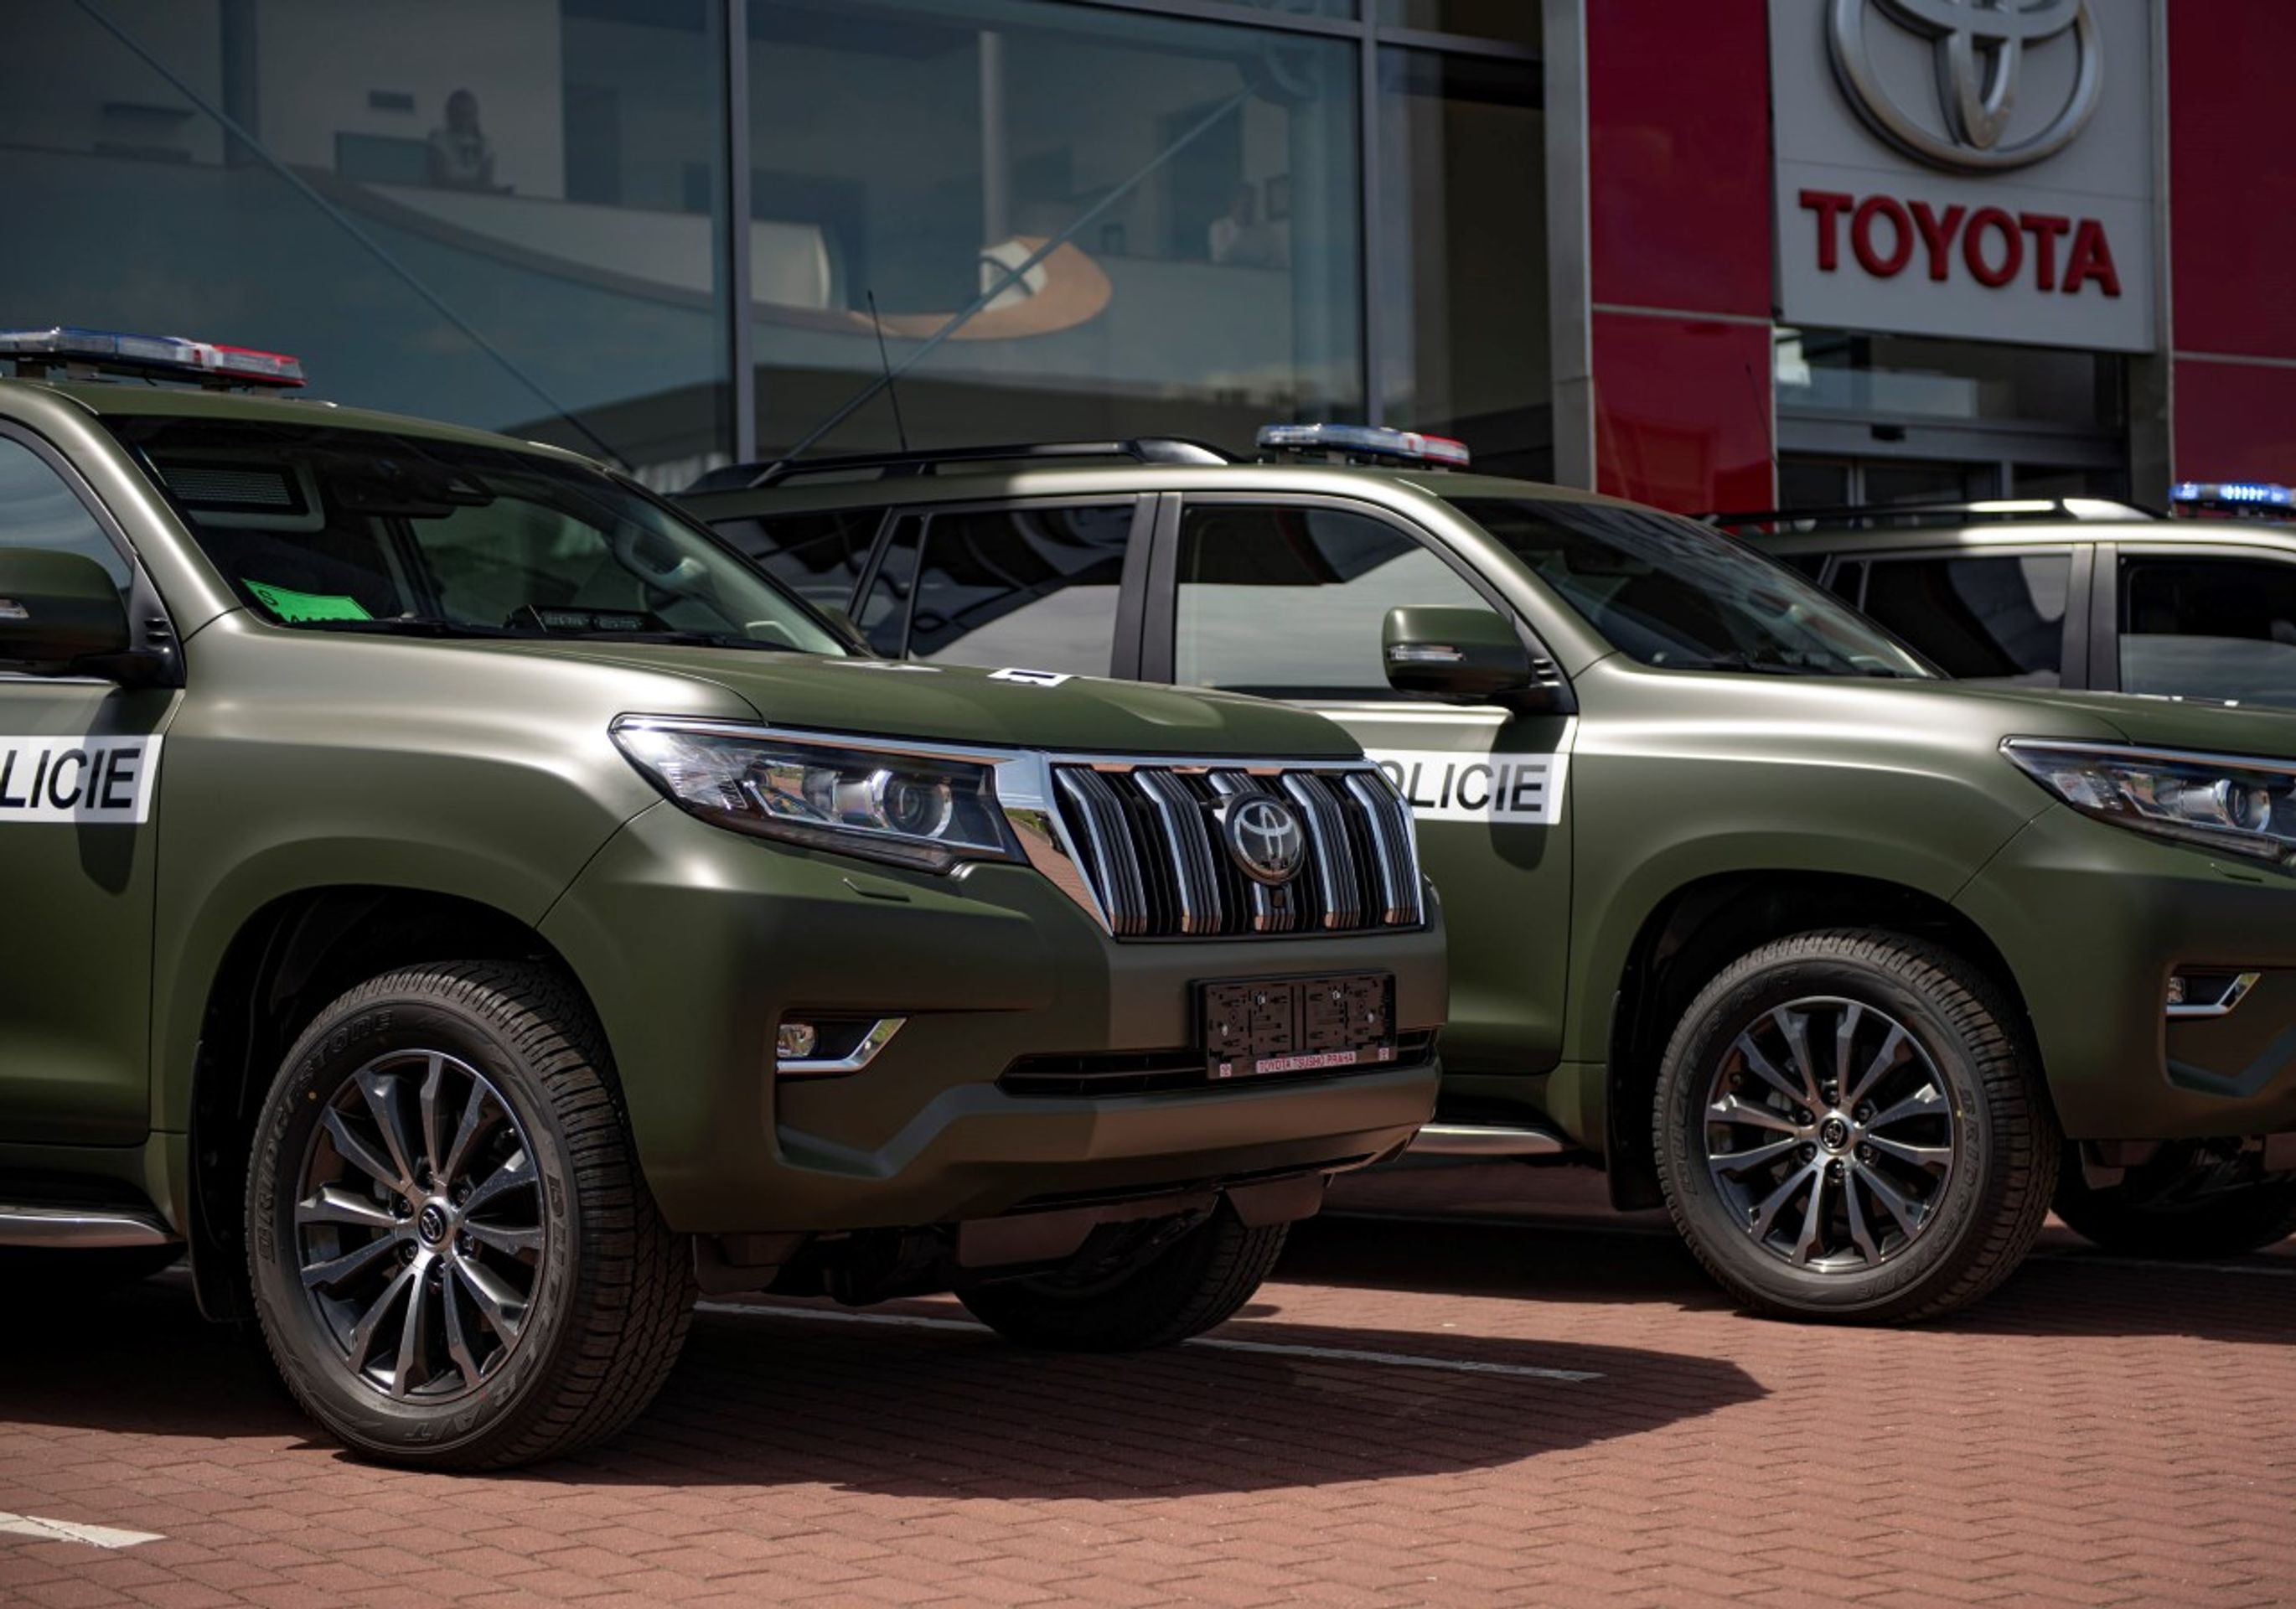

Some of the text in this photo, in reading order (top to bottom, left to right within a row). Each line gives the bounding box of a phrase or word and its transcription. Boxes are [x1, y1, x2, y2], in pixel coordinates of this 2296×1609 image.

[1798, 188, 2122, 298] TOYOTA
[0, 748, 142, 810] LICIE
[1259, 1053, 1354, 1073] TOYOTA TSUSHO PRAHA
